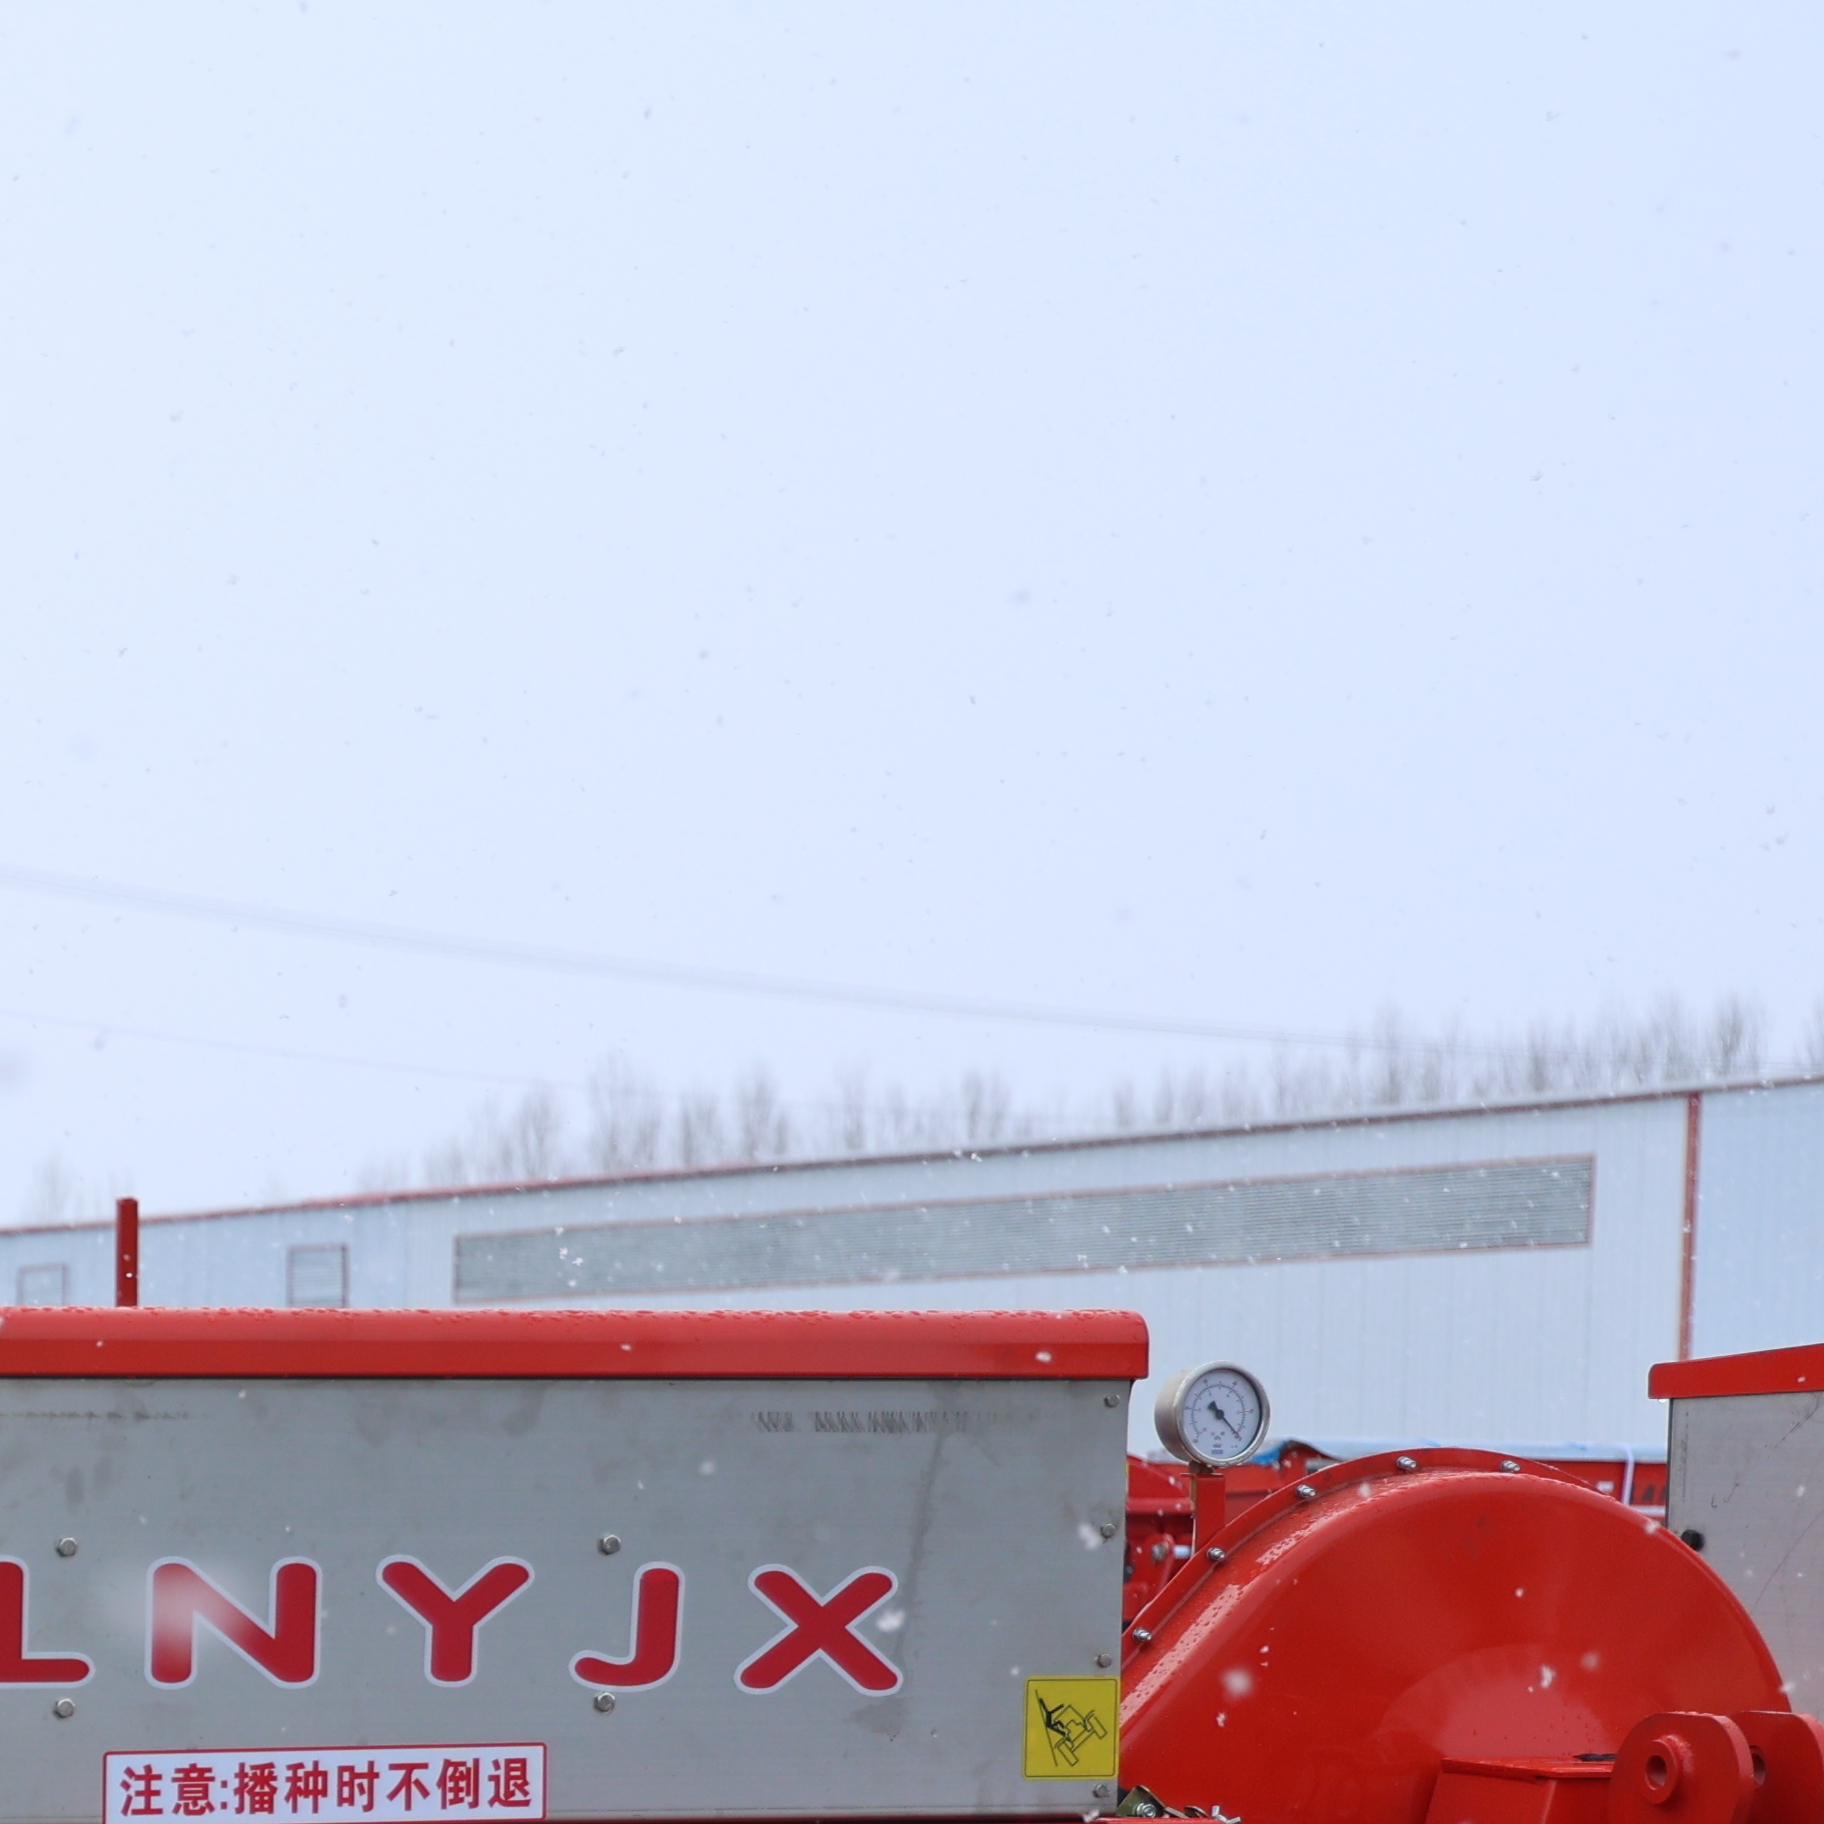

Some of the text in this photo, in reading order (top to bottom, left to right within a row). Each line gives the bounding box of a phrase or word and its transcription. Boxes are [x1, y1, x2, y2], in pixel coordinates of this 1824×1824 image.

[119, 1757, 533, 1818] 注意:播种时不倒退
